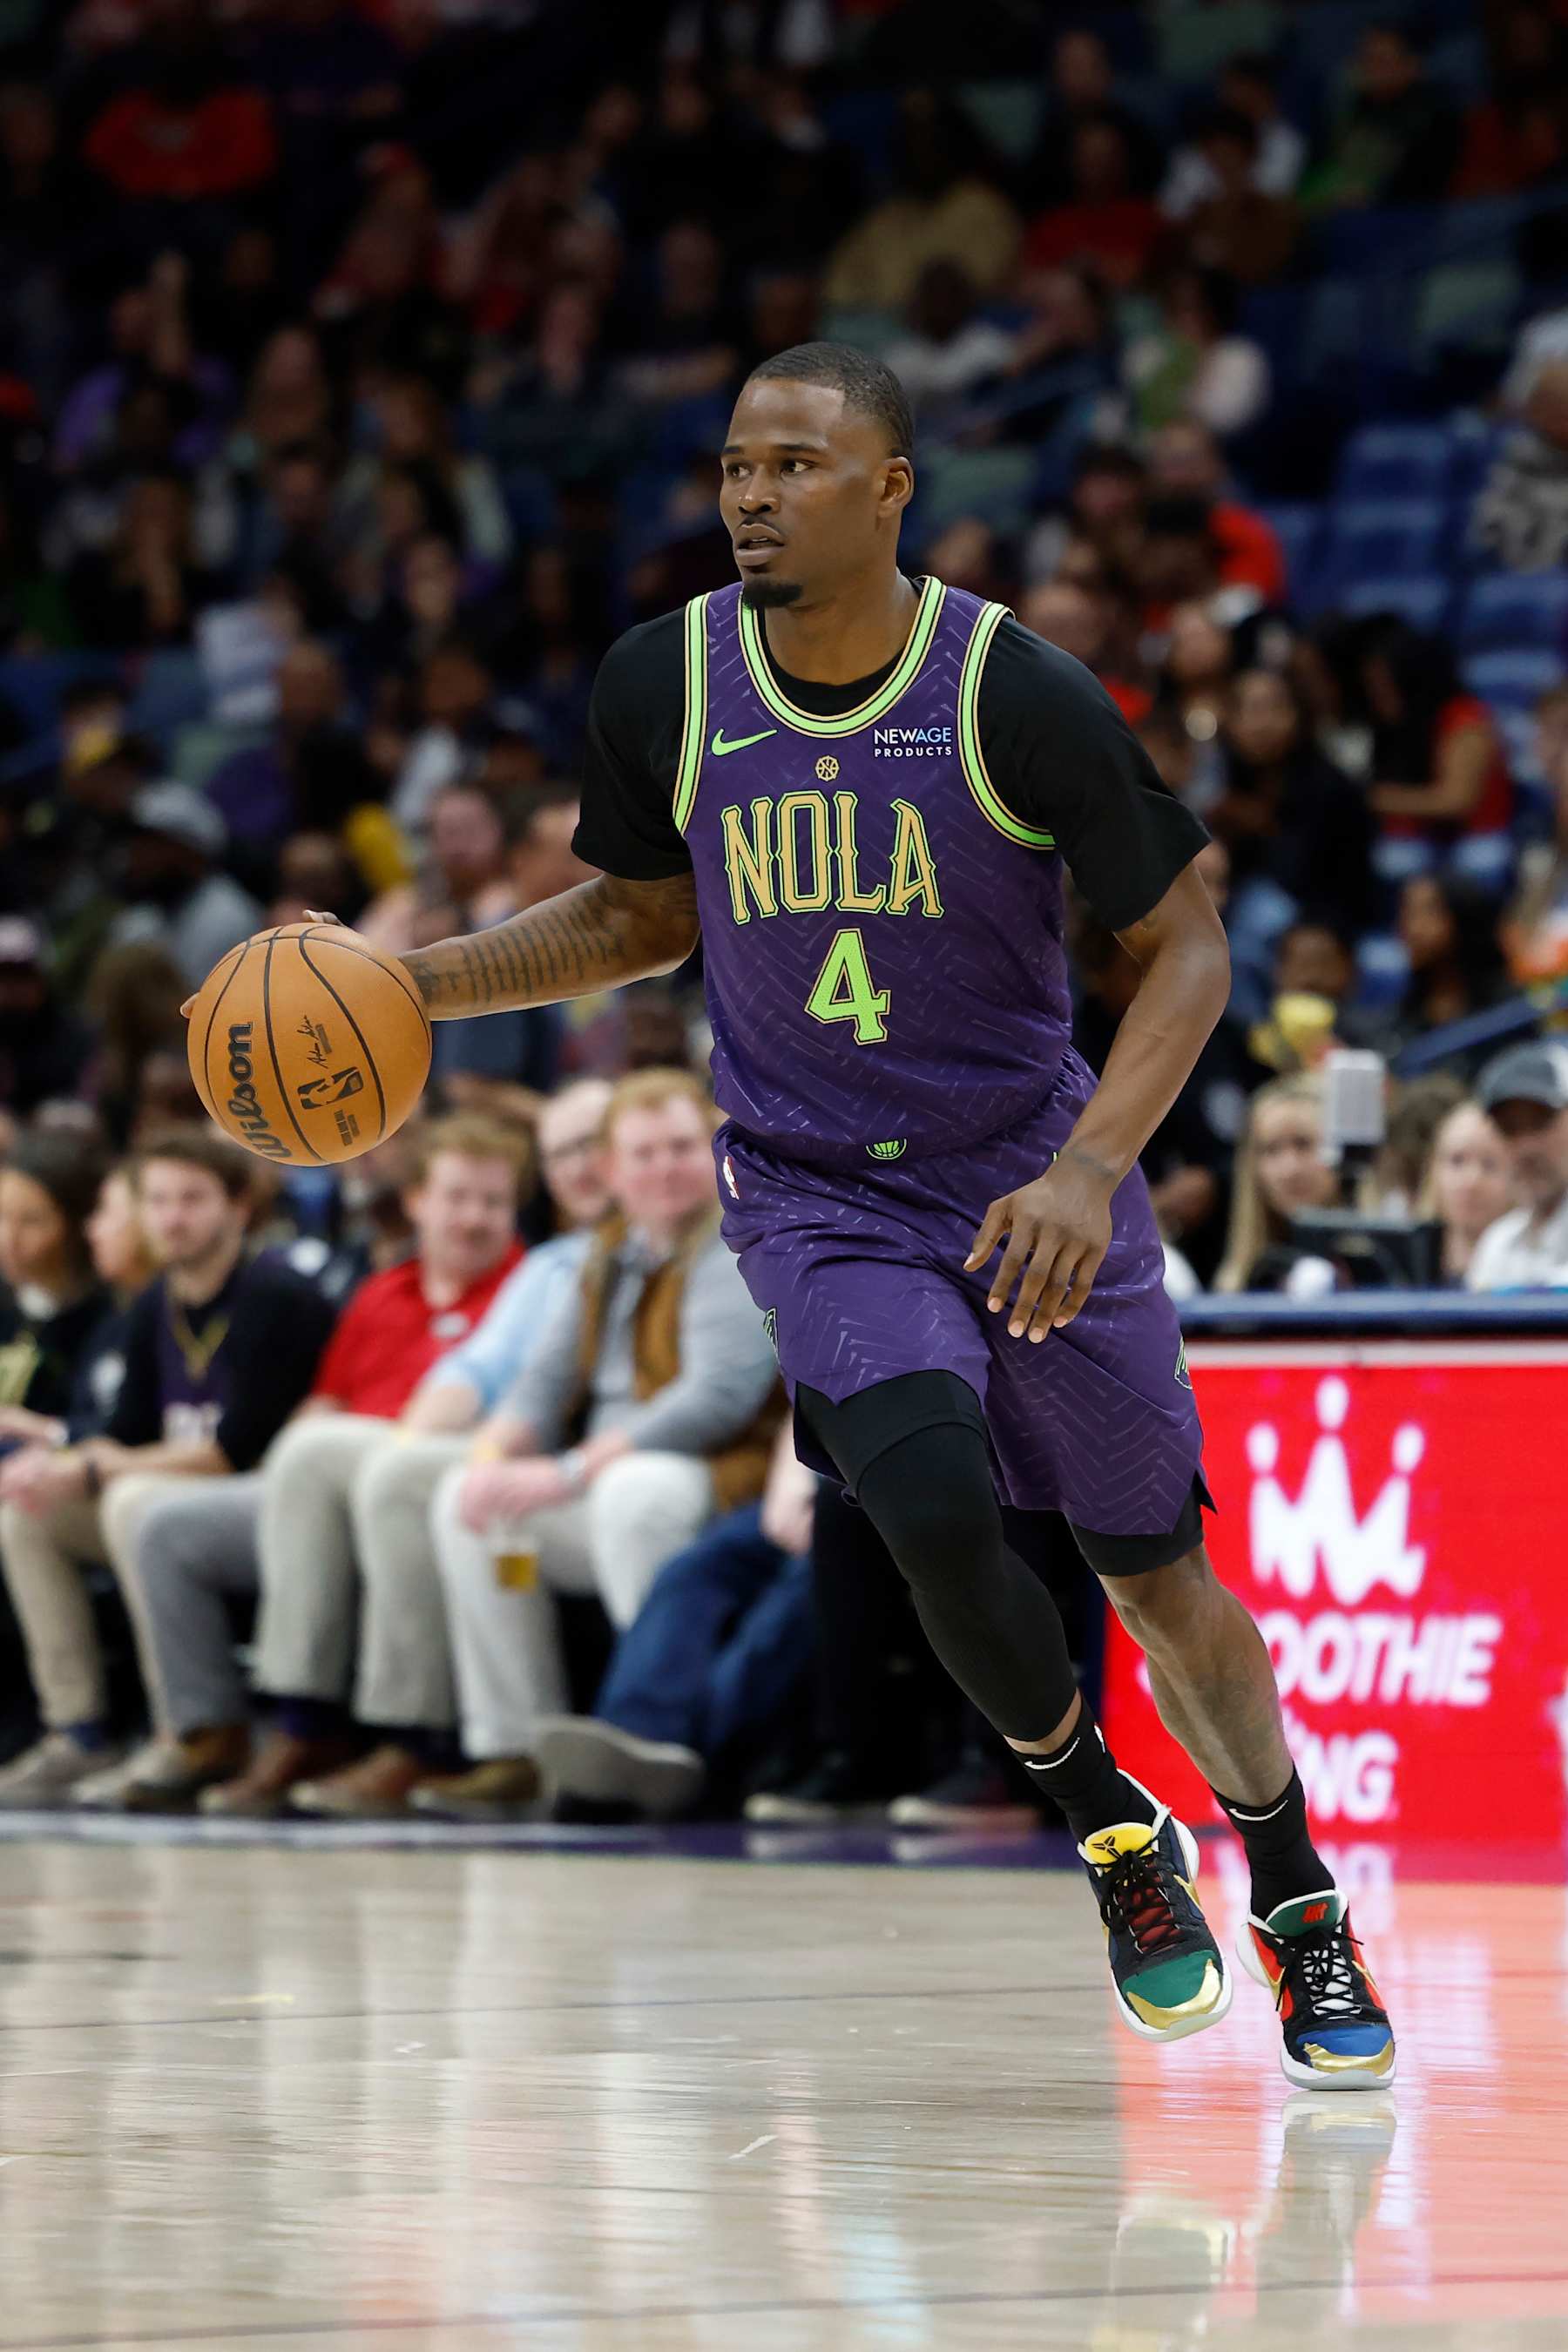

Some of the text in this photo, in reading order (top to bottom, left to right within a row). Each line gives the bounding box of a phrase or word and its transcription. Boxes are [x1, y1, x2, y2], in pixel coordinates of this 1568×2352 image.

[874, 747, 952, 758] PRODUCTS
[720, 790, 945, 925] NOLA
[804, 928, 892, 1045] 4
[227, 1022, 292, 1157] Wilson
[1137, 1612, 1501, 1706] OOTHIE
